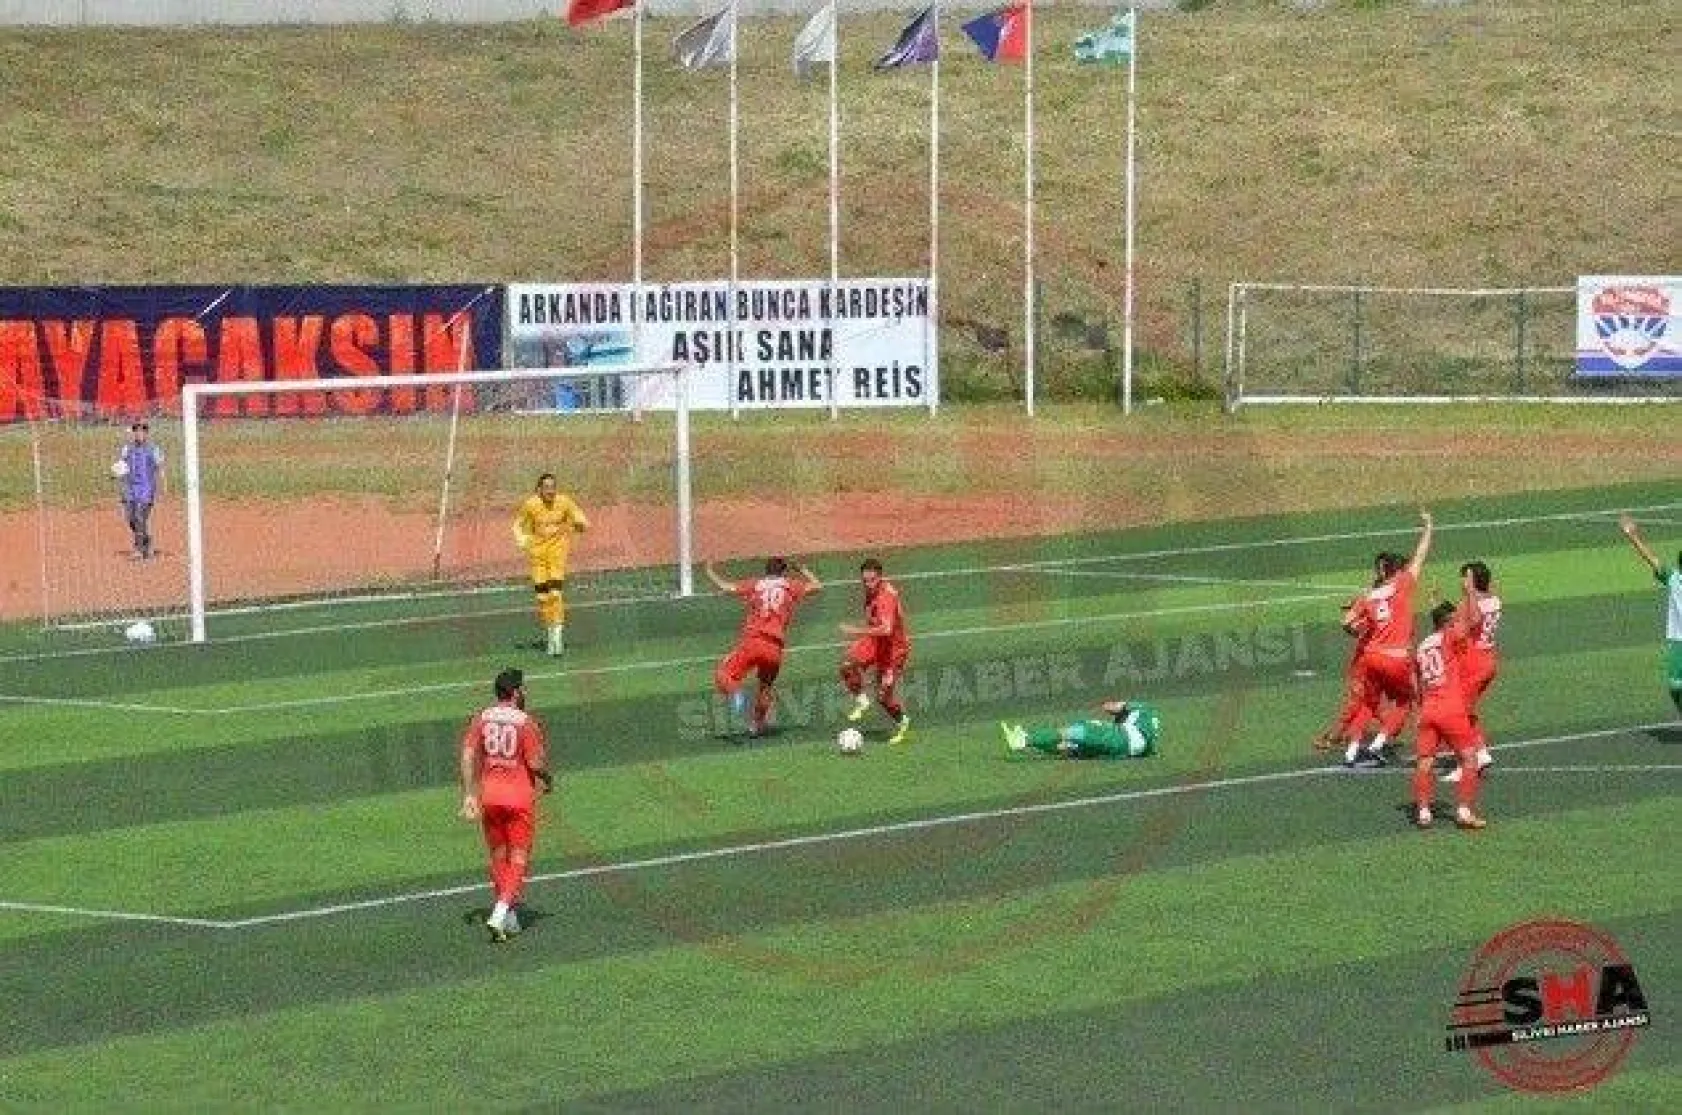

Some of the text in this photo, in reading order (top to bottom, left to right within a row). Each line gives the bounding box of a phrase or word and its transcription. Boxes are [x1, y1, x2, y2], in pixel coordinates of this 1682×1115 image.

[518, 292, 621, 324] ARKANDA
[735, 288, 812, 321] BUNCA
[819, 282, 929, 323] KARDEŞİN
[756, 328, 833, 361] SANA
[738, 359, 921, 401] AHMET REİS
[481, 722, 517, 757] 80
